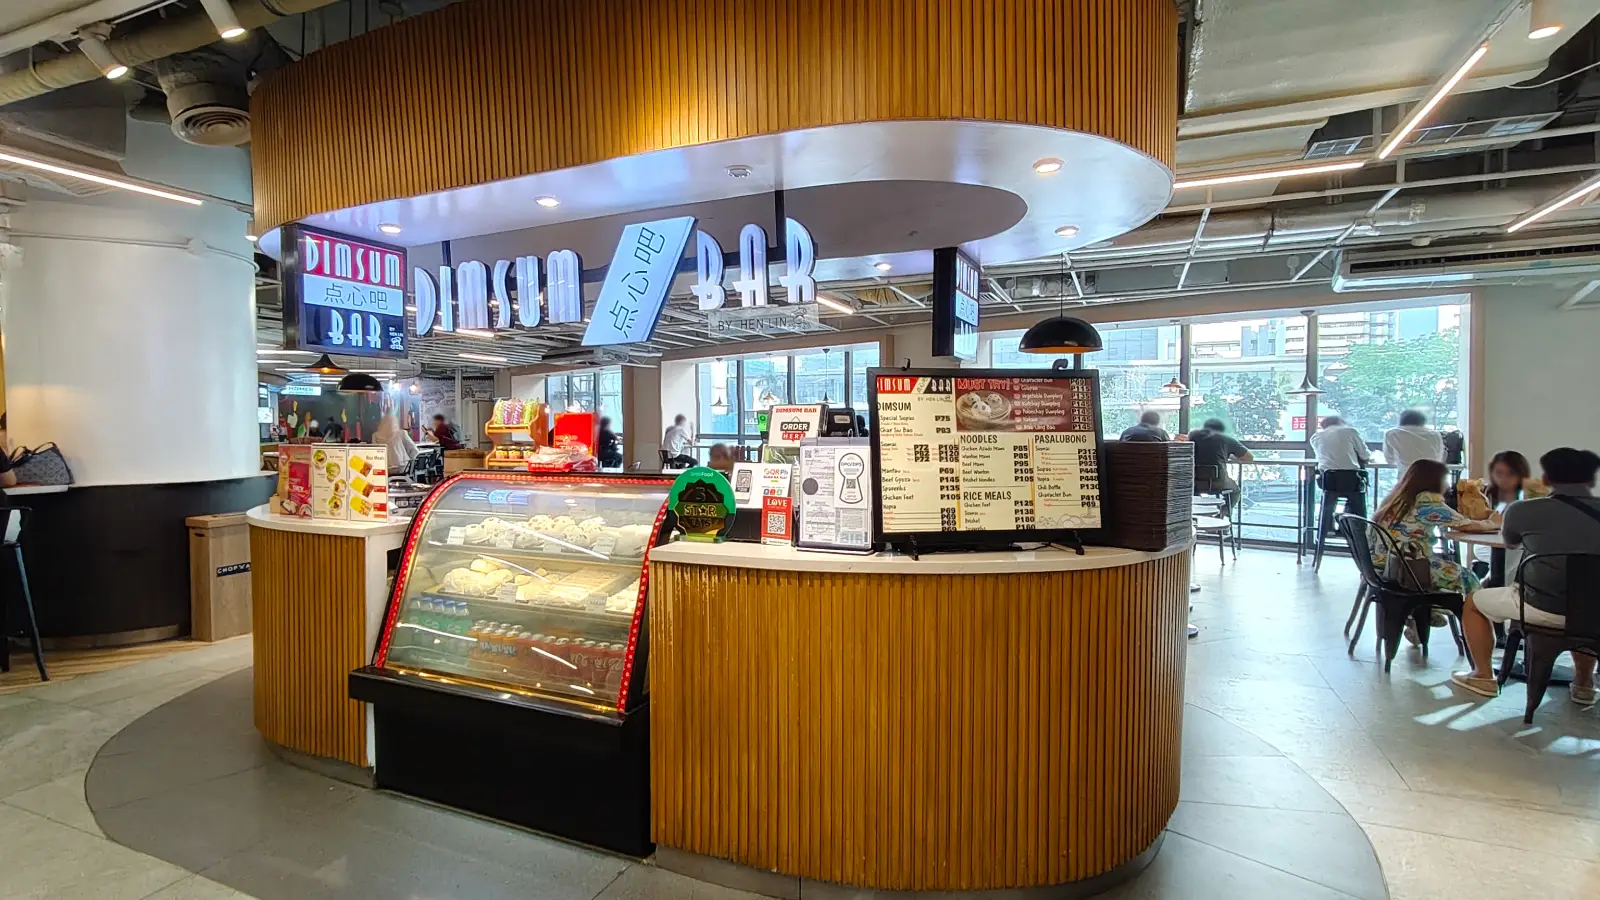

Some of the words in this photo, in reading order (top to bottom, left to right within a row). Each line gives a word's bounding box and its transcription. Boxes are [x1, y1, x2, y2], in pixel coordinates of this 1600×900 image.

[305, 236, 400, 286] DIMSUM
[689, 217, 816, 310] BAR
[609, 227, 666, 339] 点心吧
[324, 283, 388, 310] 点心吧
[415, 249, 582, 335] DIMSUM
[328, 309, 381, 349] BAR
[718, 320, 733, 331] BY
[740, 318, 764, 330] HEN
[769, 317, 787, 329] LIN
[877, 379, 910, 391] IMSUM
[931, 380, 951, 391] BAR
[958, 379, 985, 390] MUST
[877, 402, 911, 411] DIMSUM
[961, 435, 997, 443] NOODLES
[1035, 435, 1087, 443] PASALUBONG
[696, 487, 706, 501] 3
[963, 491, 982, 500] RICE
[985, 491, 1011, 500] MEALS
[767, 498, 787, 507] LOVE
